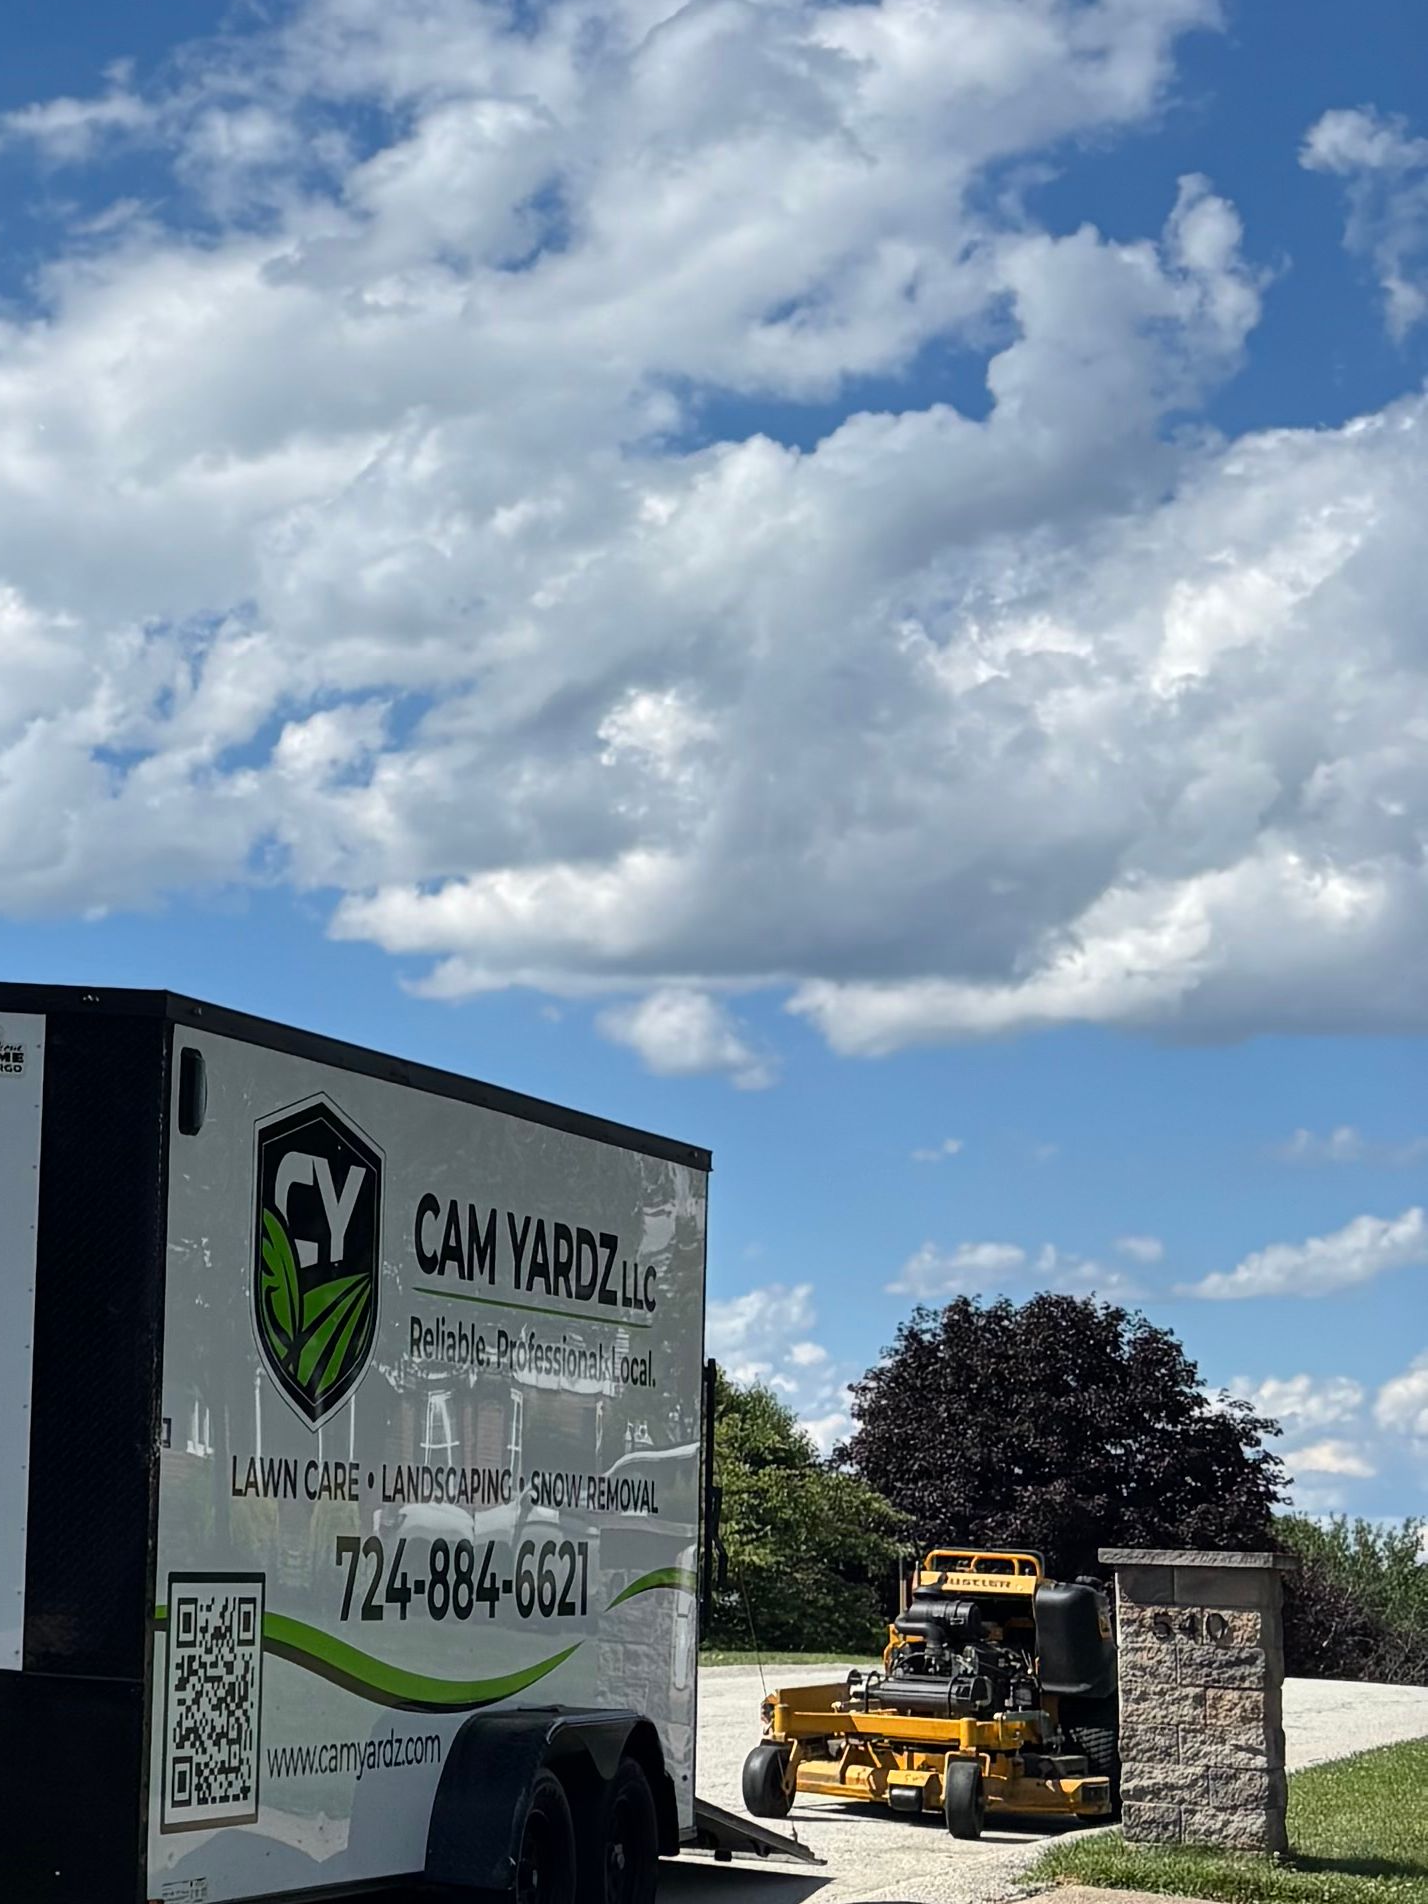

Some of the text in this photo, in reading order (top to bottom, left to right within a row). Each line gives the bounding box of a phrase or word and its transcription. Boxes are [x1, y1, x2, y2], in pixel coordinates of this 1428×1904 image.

[275, 1151, 366, 1268] CY
[415, 1193, 657, 1313] CAM YARDZ LLC
[410, 1316, 490, 1366] Reliable.
[611, 1346, 656, 1388] Local.
[232, 1455, 658, 1513] LAWN CARE LANDSCAPING SNOW REMOVAL
[336, 1536, 588, 1621] 724-884-6621
[947, 1576, 1012, 1589] USTLER
[1152, 1612, 1227, 1641] 540
[267, 1728, 441, 1781] www.camyardz.com
